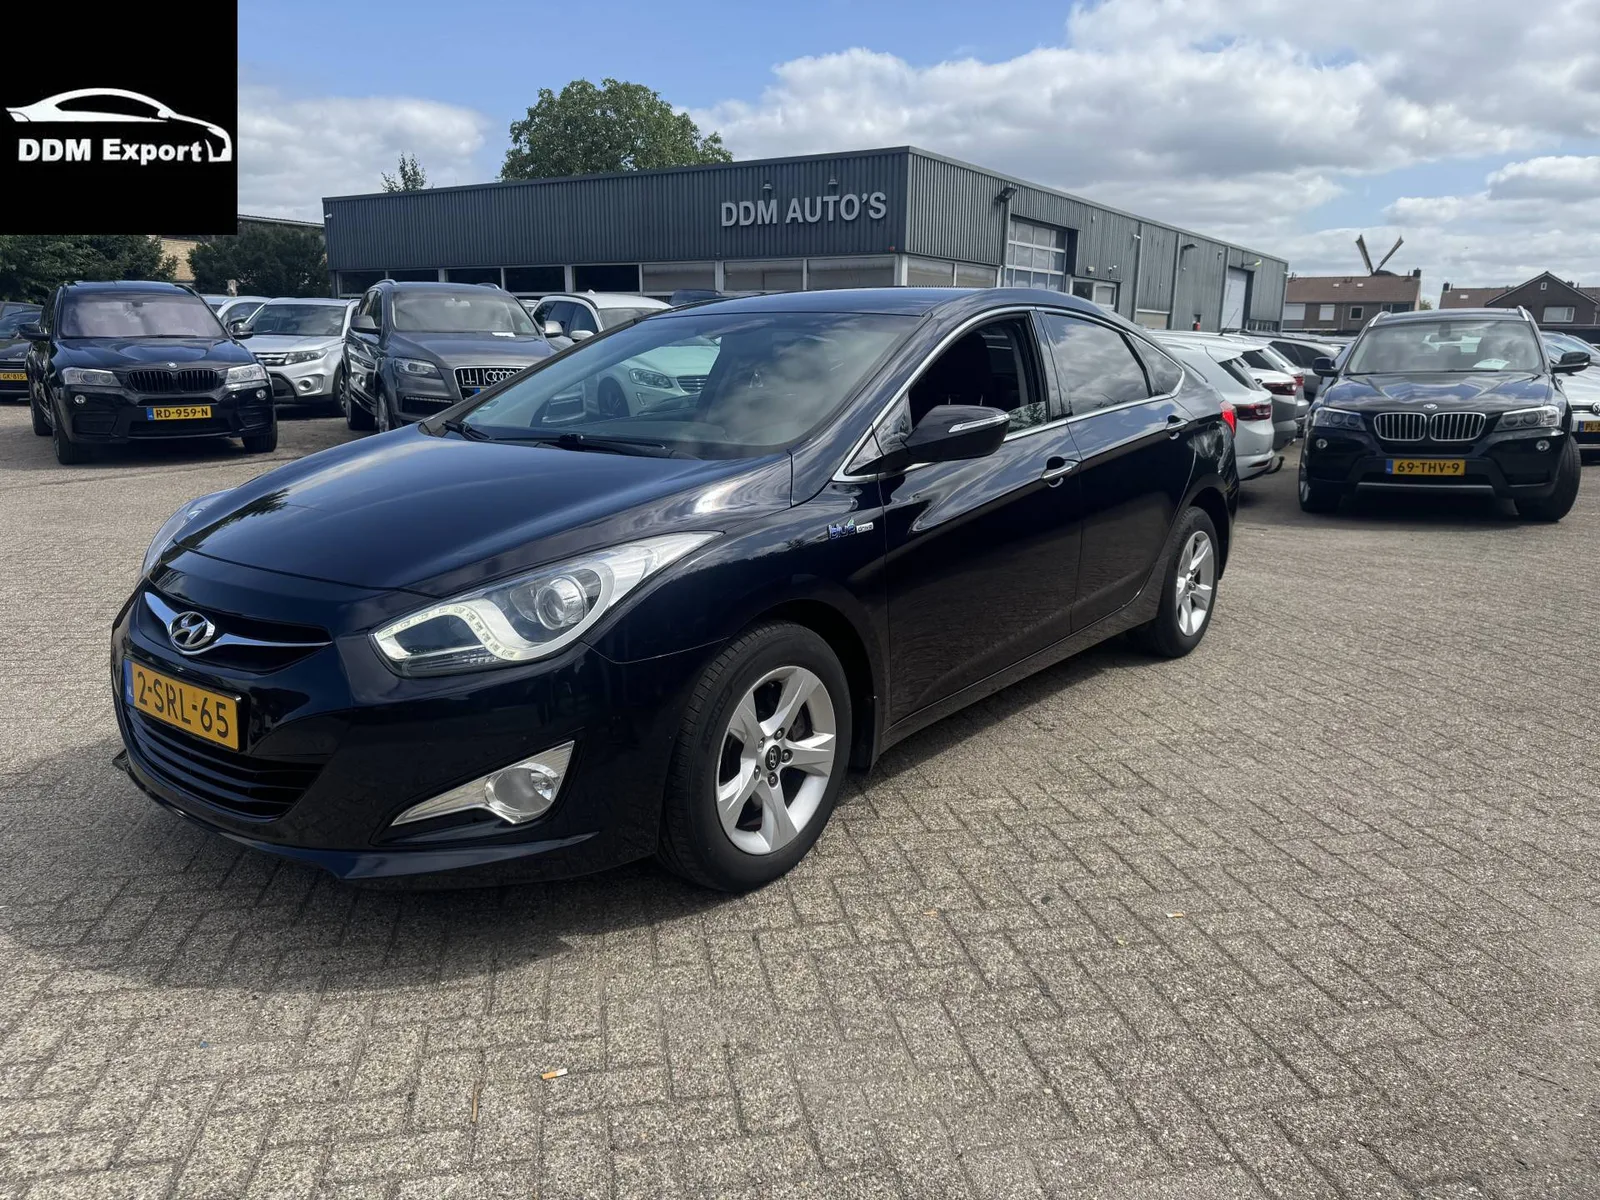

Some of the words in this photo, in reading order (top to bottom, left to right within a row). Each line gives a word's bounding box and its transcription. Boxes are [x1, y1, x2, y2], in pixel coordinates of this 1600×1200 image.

[721, 199, 778, 227] DDM
[785, 191, 887, 225] AUTO'S
[155, 407, 208, 418] RD-959-N
[1397, 462, 1460, 473] 69-THV-9
[137, 671, 229, 738] 2-SRL-65
